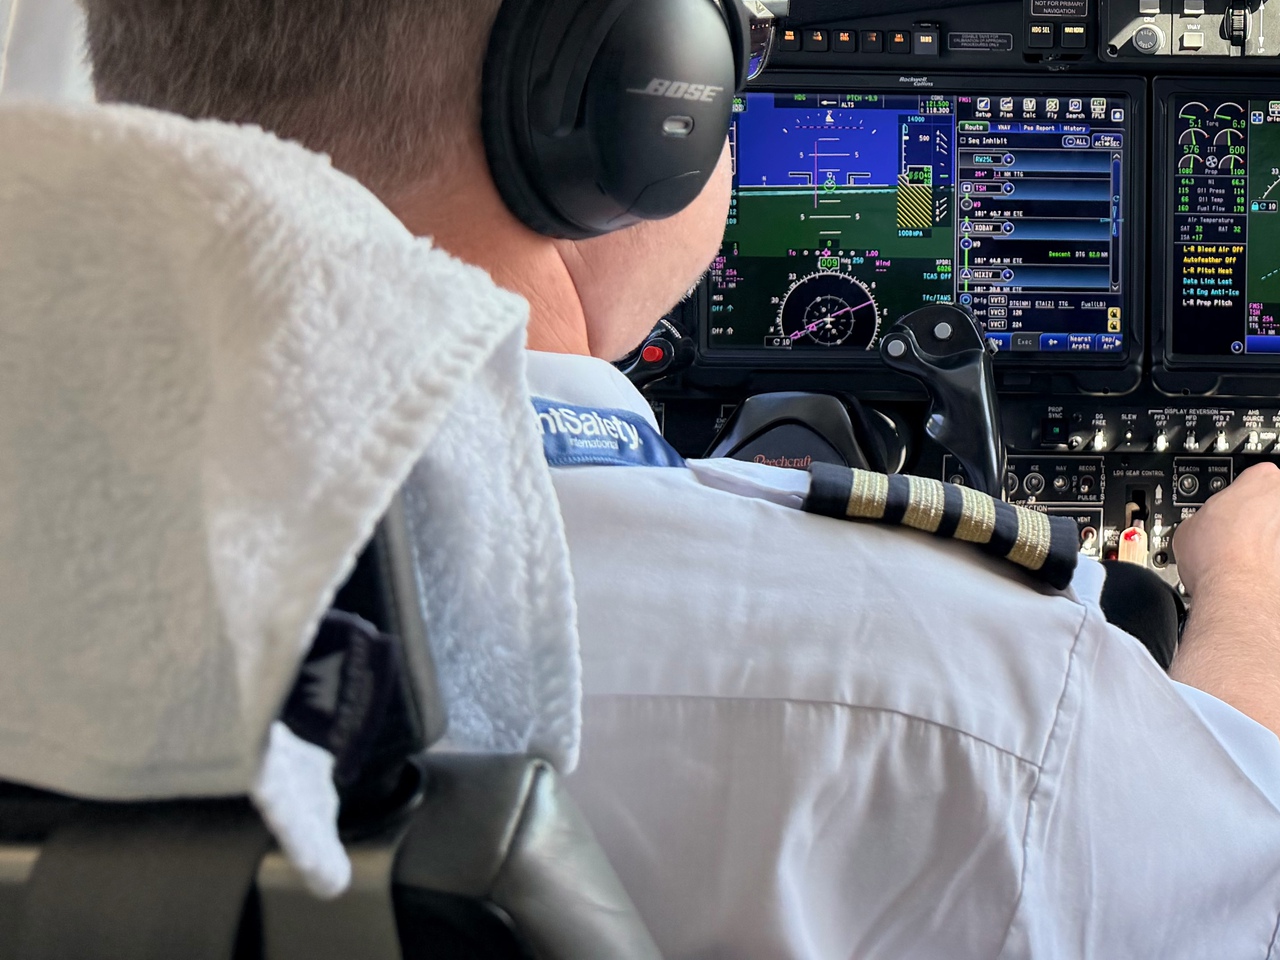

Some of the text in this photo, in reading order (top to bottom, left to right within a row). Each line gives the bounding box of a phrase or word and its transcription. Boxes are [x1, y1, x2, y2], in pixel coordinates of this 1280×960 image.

[626, 78, 724, 102] BOSE
[1232, 120, 1246, 128] 6.9
[1184, 145, 1245, 154] 576 600
[1197, 246, 1216, 254] Bleed
[1218, 246, 1230, 254] Air
[1232, 245, 1244, 253] Off
[1197, 266, 1216, 274] Pitot
[1200, 277, 1216, 285] Link
[1218, 278, 1233, 286] Lost
[1196, 288, 1208, 297] Eng
[1196, 299, 1212, 307] Prop
[1214, 299, 1232, 307] Pitch
